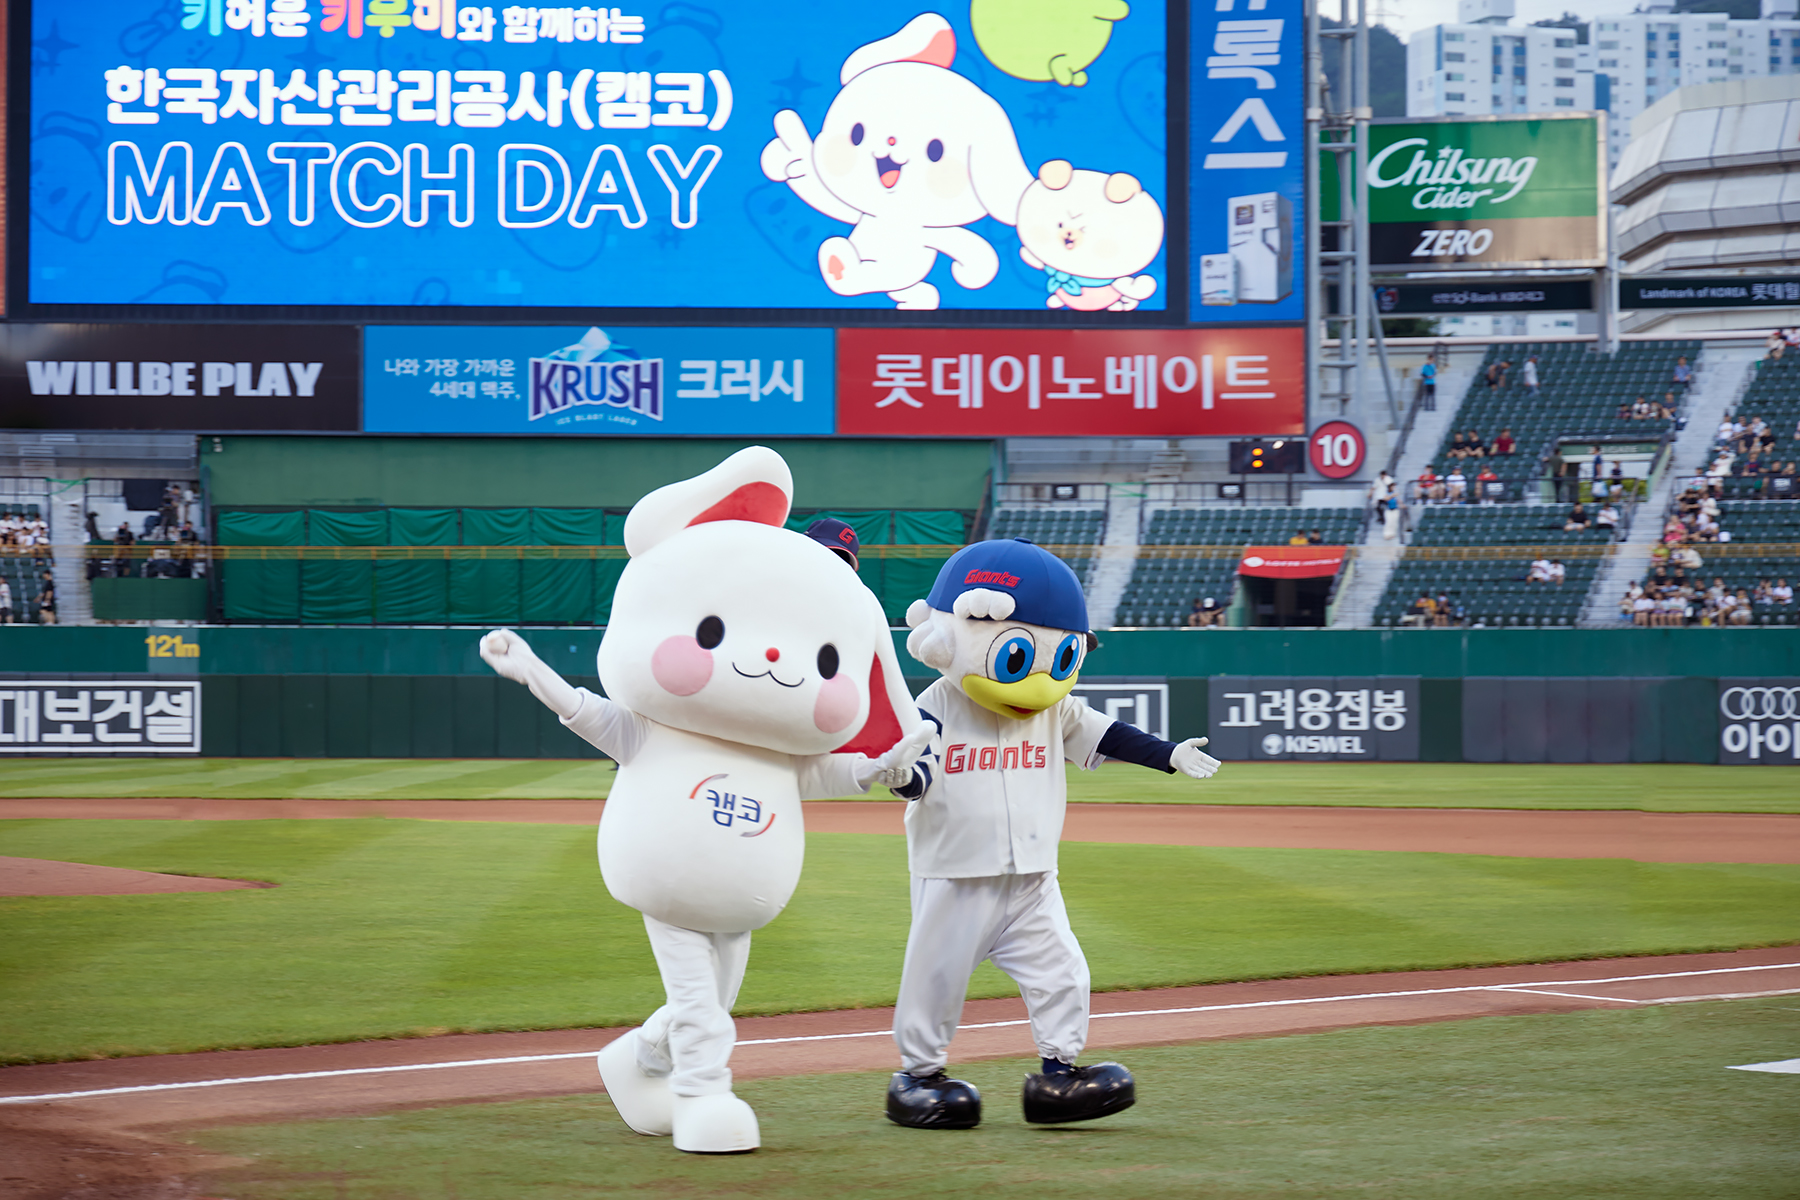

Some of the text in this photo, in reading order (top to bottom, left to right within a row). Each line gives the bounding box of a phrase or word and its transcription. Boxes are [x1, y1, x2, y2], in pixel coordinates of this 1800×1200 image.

[502, 5, 646, 44] 함께하는
[103, 65, 733, 131] 한국자산관리공사(캠코)
[1203, 0, 1288, 169] 록스
[106, 141, 723, 229] MATCH DAY
[1367, 137, 1538, 204] Chilsung
[1411, 186, 1494, 209] Cider
[1410, 228, 1494, 256] ZERO
[1639, 287, 1694, 299] Landmark
[1696, 287, 1709, 298] of
[1710, 287, 1749, 298] KOREA
[26, 361, 324, 397] WILLBE PLAY
[384, 358, 516, 377] 나와 가장 가까운
[676, 358, 804, 402] 크러시
[872, 353, 1276, 410] 롯데이노베이트
[429, 380, 521, 400] 4세대 맥주,
[528, 357, 663, 421] KRUSH
[1316, 433, 1357, 467] 10
[838, 527, 855, 544] G
[964, 568, 1021, 588] Giants
[145, 635, 200, 658] 121m
[0, 690, 193, 743] 대보건설
[1219, 688, 1408, 731] 고려용접봉
[944, 740, 1047, 775] Giants
[1284, 735, 1366, 754] KISWEL
[706, 788, 761, 828] 캠코
